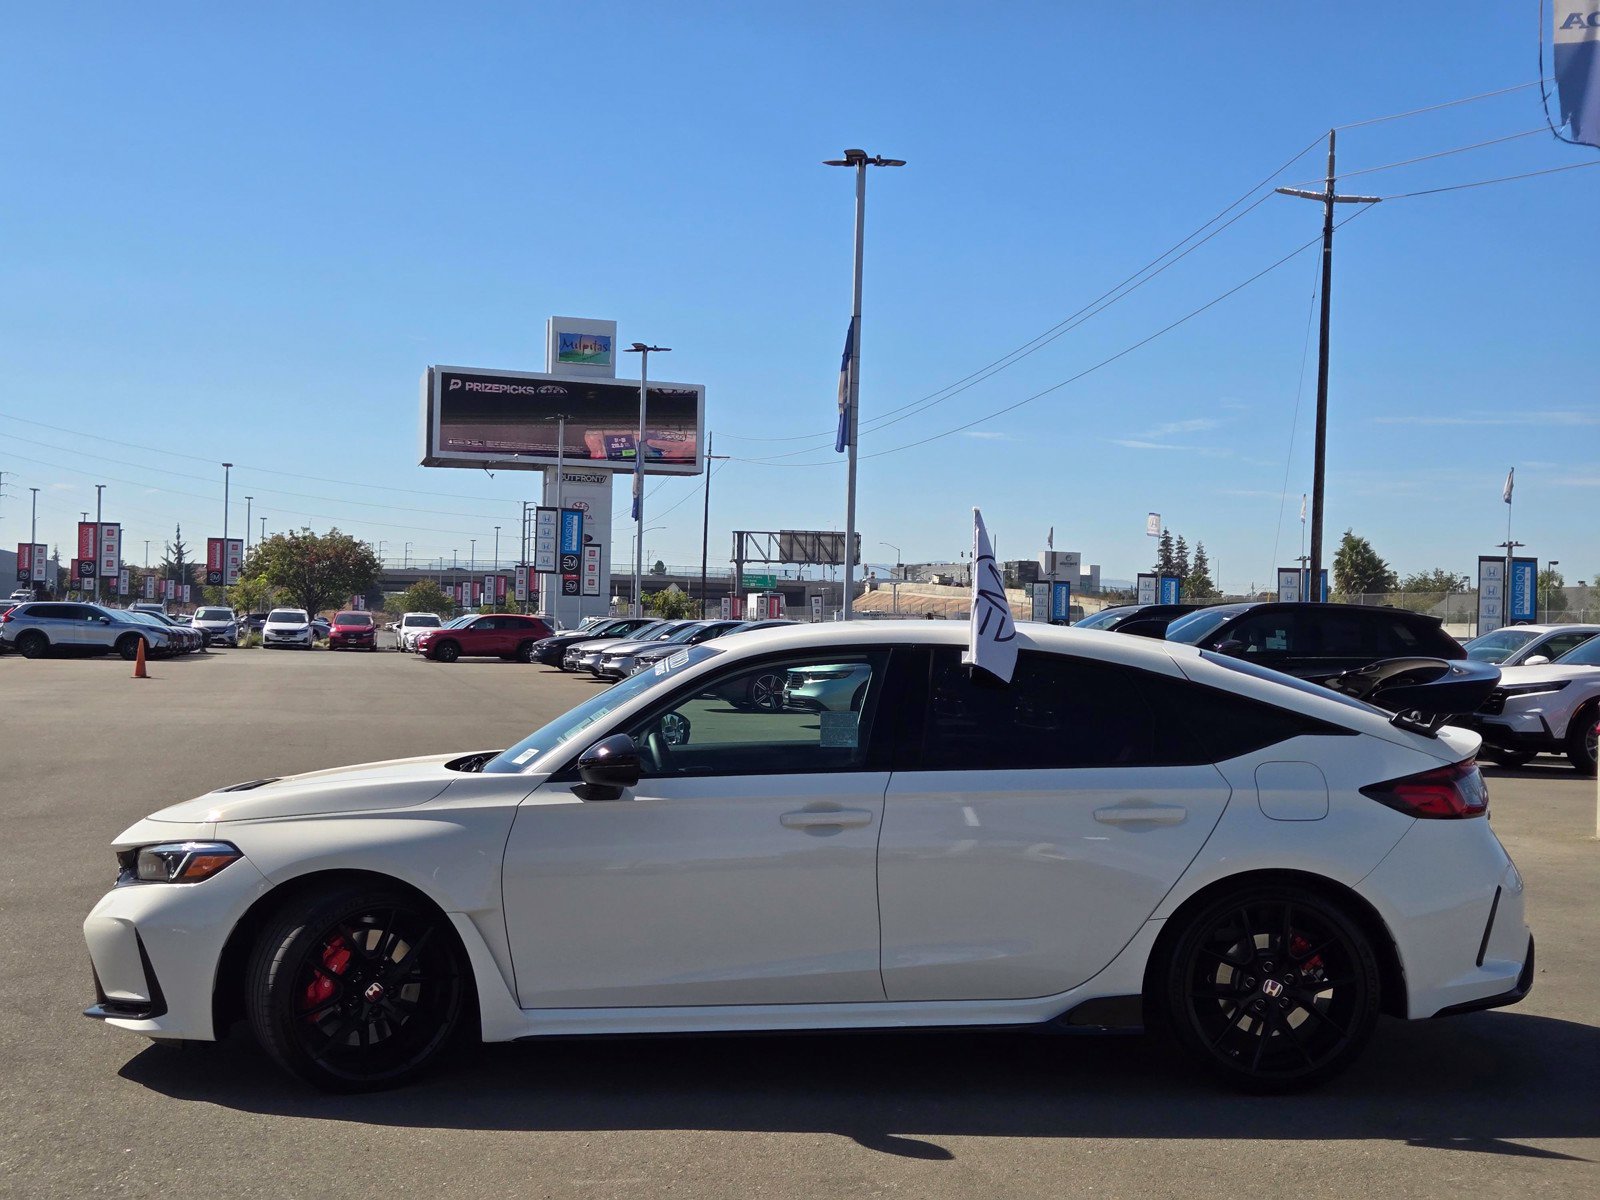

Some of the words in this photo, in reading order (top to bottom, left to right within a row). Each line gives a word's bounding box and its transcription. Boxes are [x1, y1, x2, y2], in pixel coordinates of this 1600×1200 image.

[560, 335, 608, 355] Milpitas
[465, 381, 535, 395] PRIZEPICKS
[565, 514, 574, 551] ENVISION
[1515, 566, 1525, 615] ENVISION
